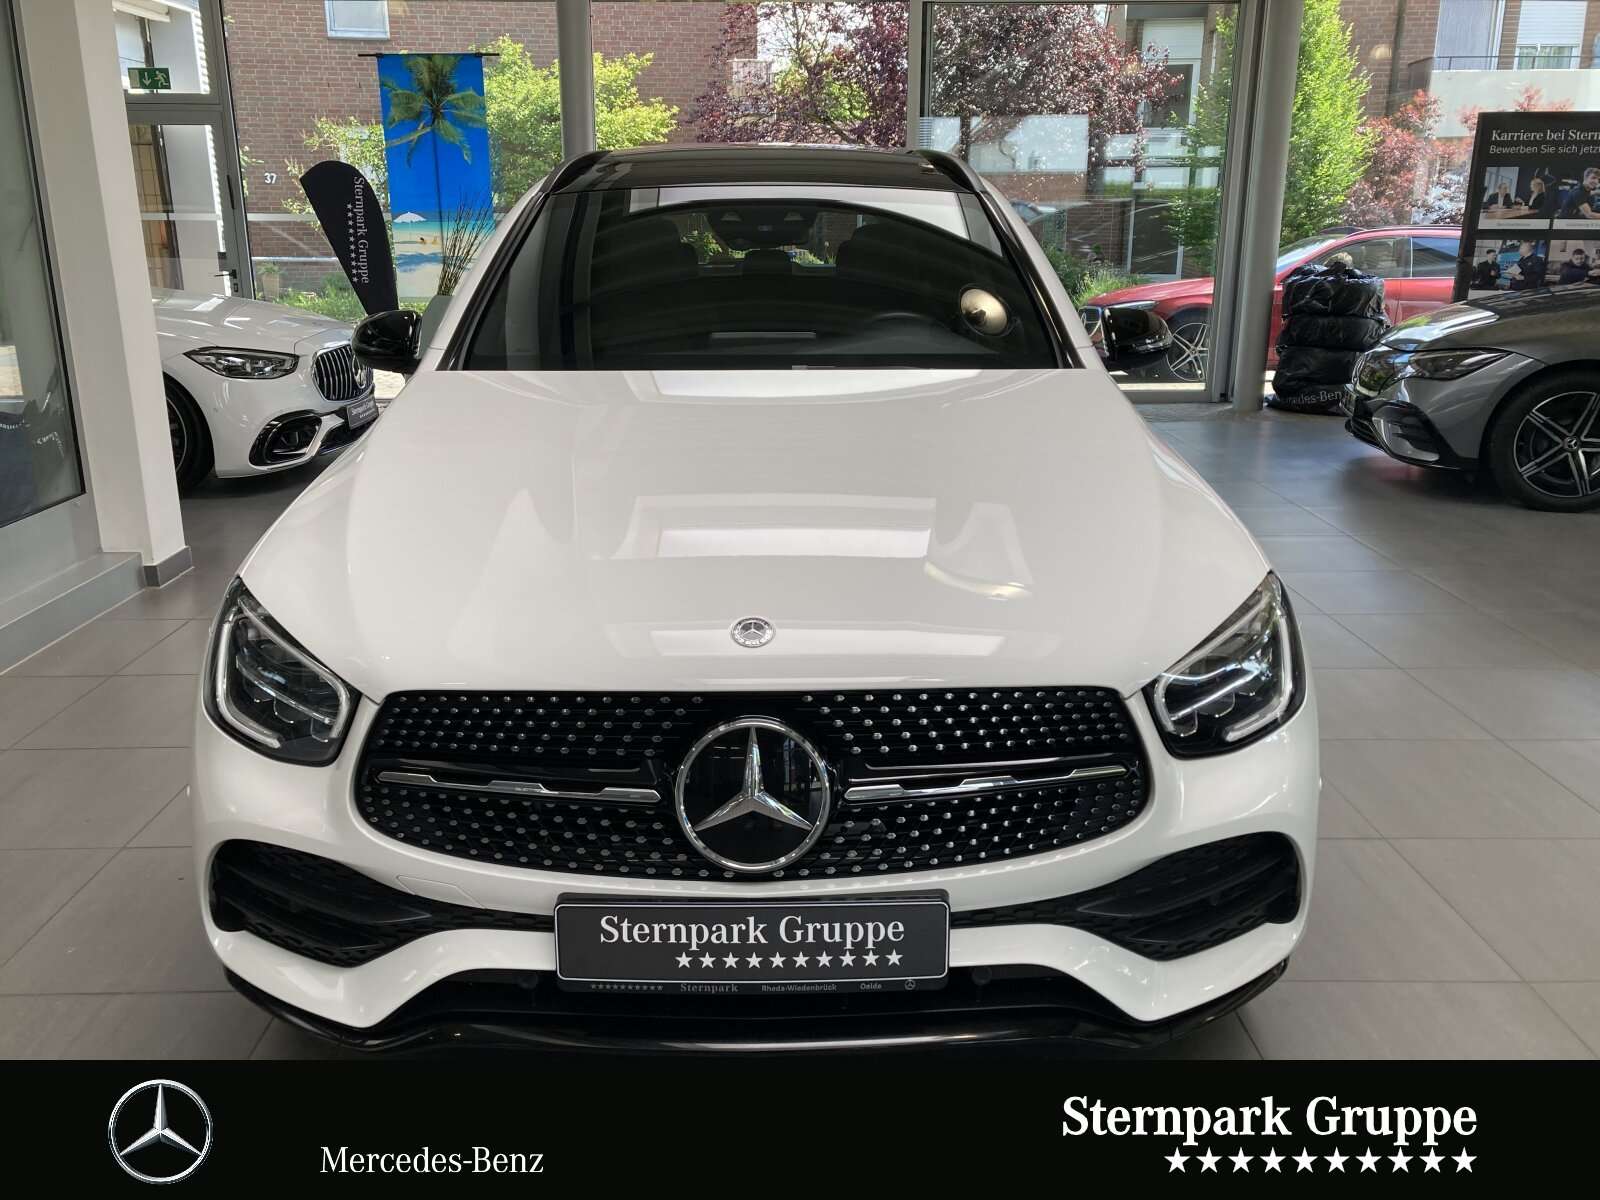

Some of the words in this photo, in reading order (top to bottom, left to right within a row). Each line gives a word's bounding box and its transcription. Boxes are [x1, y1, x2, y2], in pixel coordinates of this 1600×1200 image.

[1491, 130, 1543, 141] Karriere
[1546, 129, 1566, 141] bei
[1489, 145, 1538, 154] Bewerben
[1540, 144, 1556, 154] Sie
[1558, 144, 1578, 154] sich
[264, 172, 277, 185] 37
[353, 176, 368, 237] Sternpark
[357, 239, 370, 284] Gruppe
[600, 915, 769, 951] Sternpark
[778, 915, 905, 950] Gruppe
[680, 982, 739, 994] Sternpark
